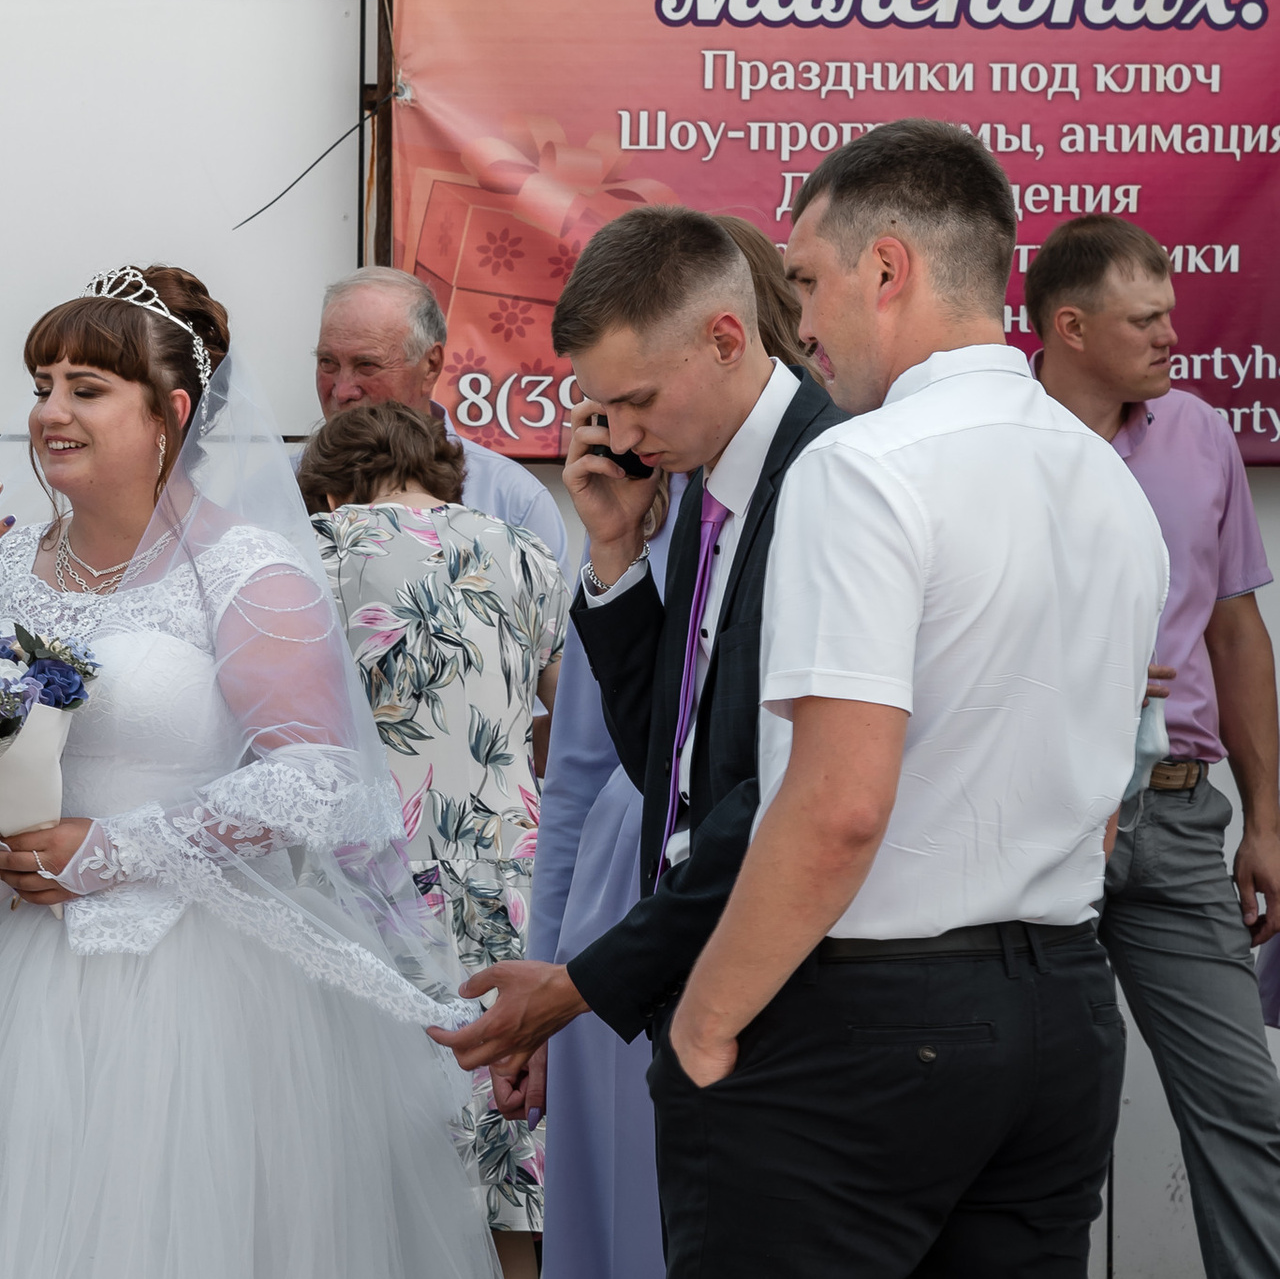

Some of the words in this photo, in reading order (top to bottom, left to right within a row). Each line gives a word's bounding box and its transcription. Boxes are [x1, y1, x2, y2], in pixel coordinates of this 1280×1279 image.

[701, 50, 974, 101] Праздники
[990, 63, 1080, 101] под
[1094, 64, 1220, 93] ключ
